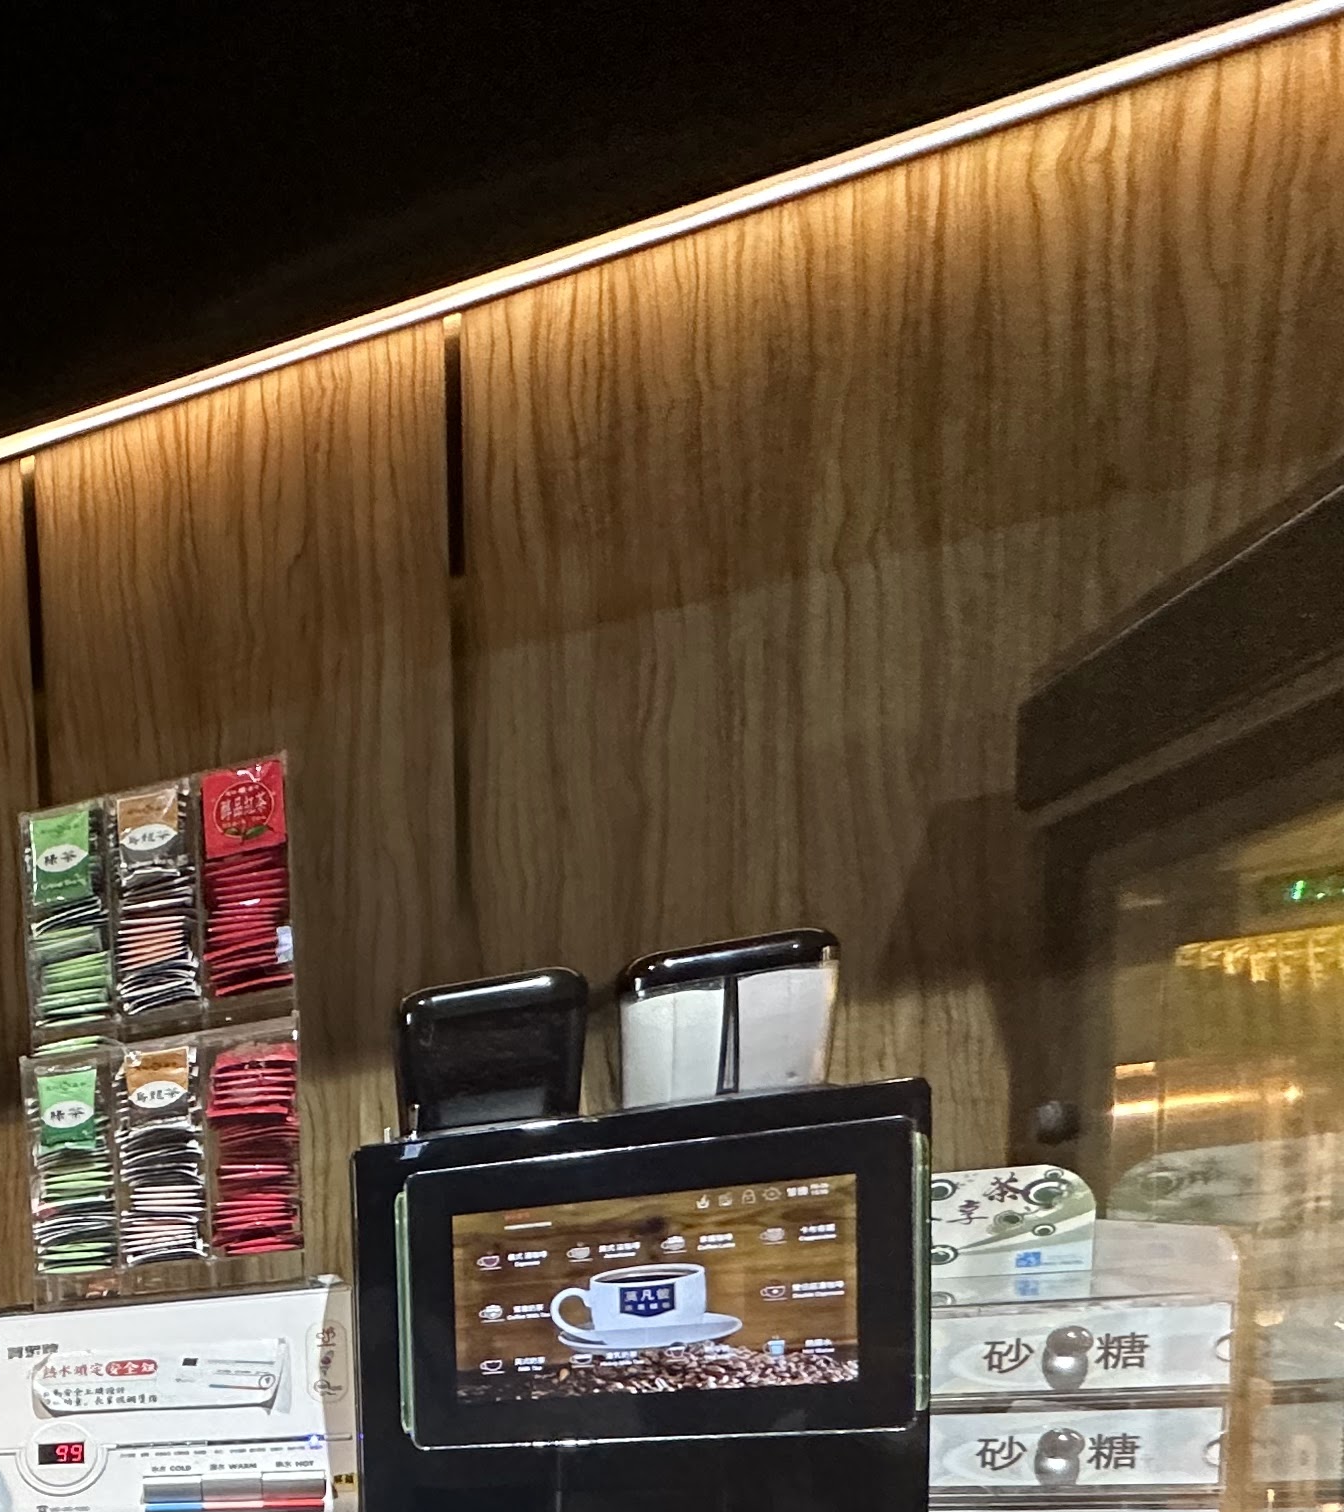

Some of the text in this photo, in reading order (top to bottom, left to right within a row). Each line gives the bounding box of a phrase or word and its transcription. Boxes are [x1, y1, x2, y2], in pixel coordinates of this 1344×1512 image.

[983, 1332, 1149, 1374] 砂糖
[55, 1444, 84, 1462] 99
[976, 1432, 1140, 1472] 砂糖
